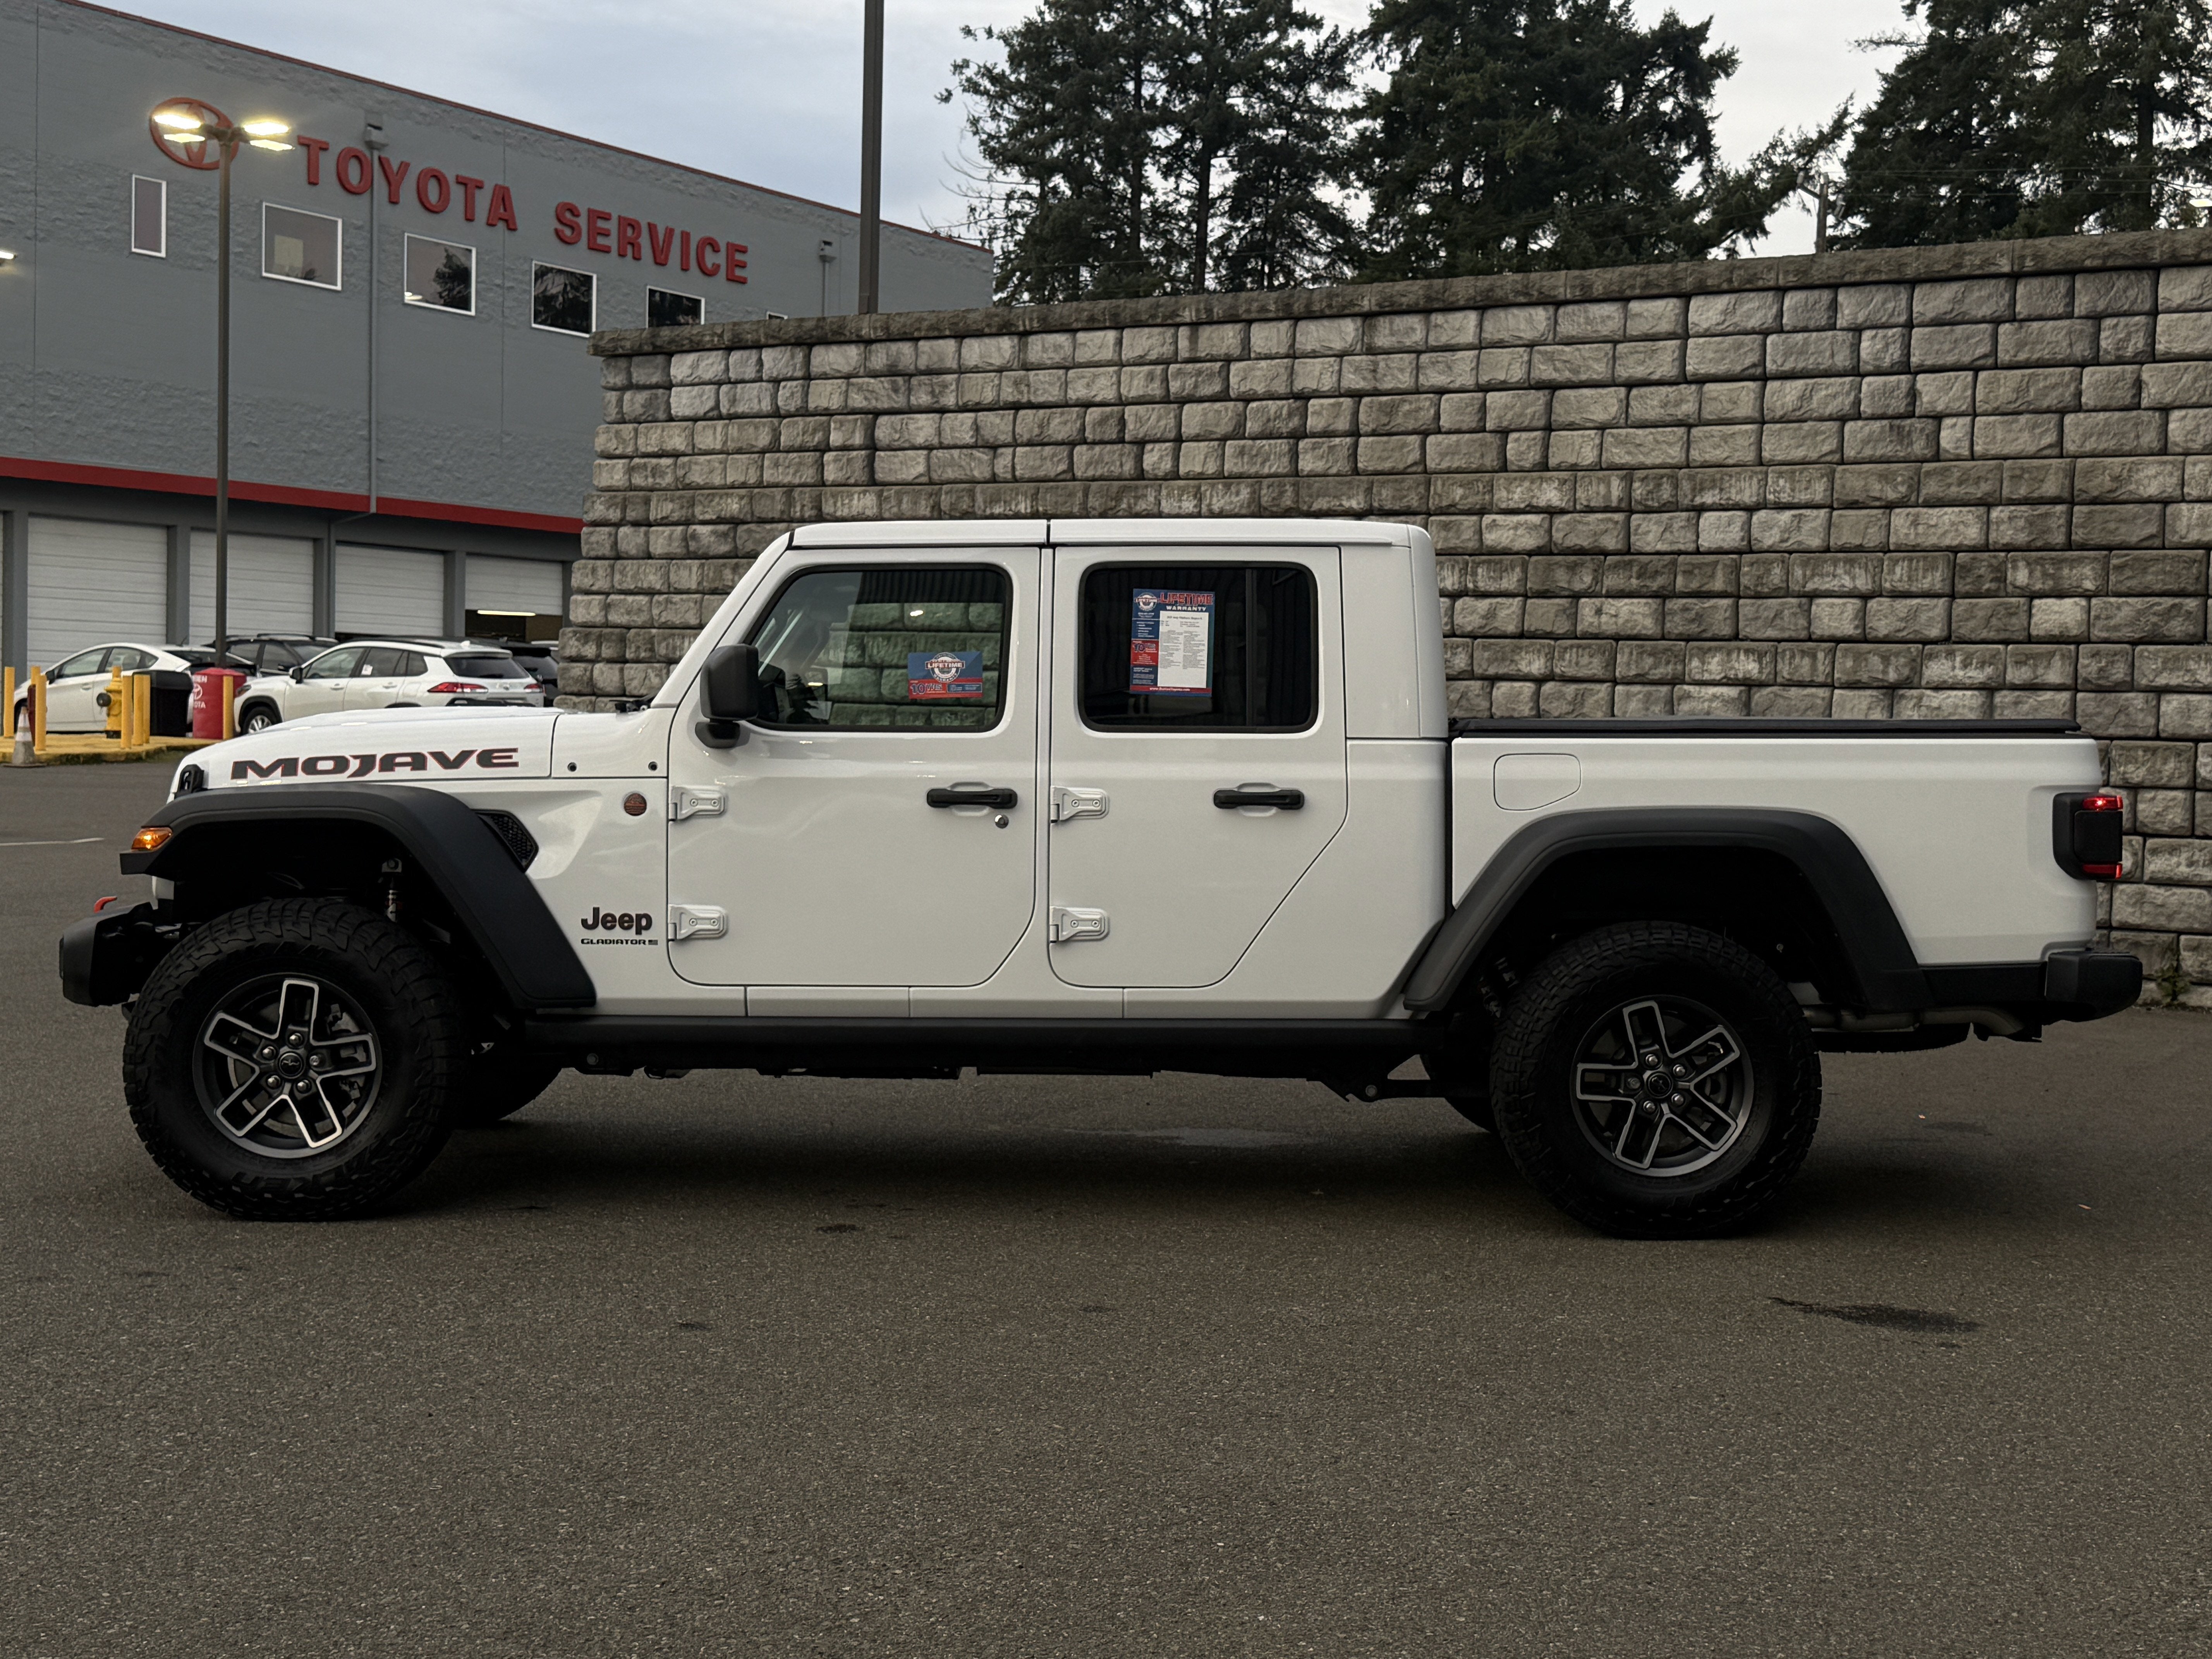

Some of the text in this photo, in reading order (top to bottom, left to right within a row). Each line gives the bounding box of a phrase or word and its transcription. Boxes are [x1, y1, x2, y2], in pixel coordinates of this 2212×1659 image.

[298, 135, 748, 284] TOYOTA SERVICE
[1160, 592, 1212, 605] LIFETIME
[910, 683, 926, 694] 10
[231, 748, 519, 780] MOJAVE
[581, 907, 653, 935] Jeep
